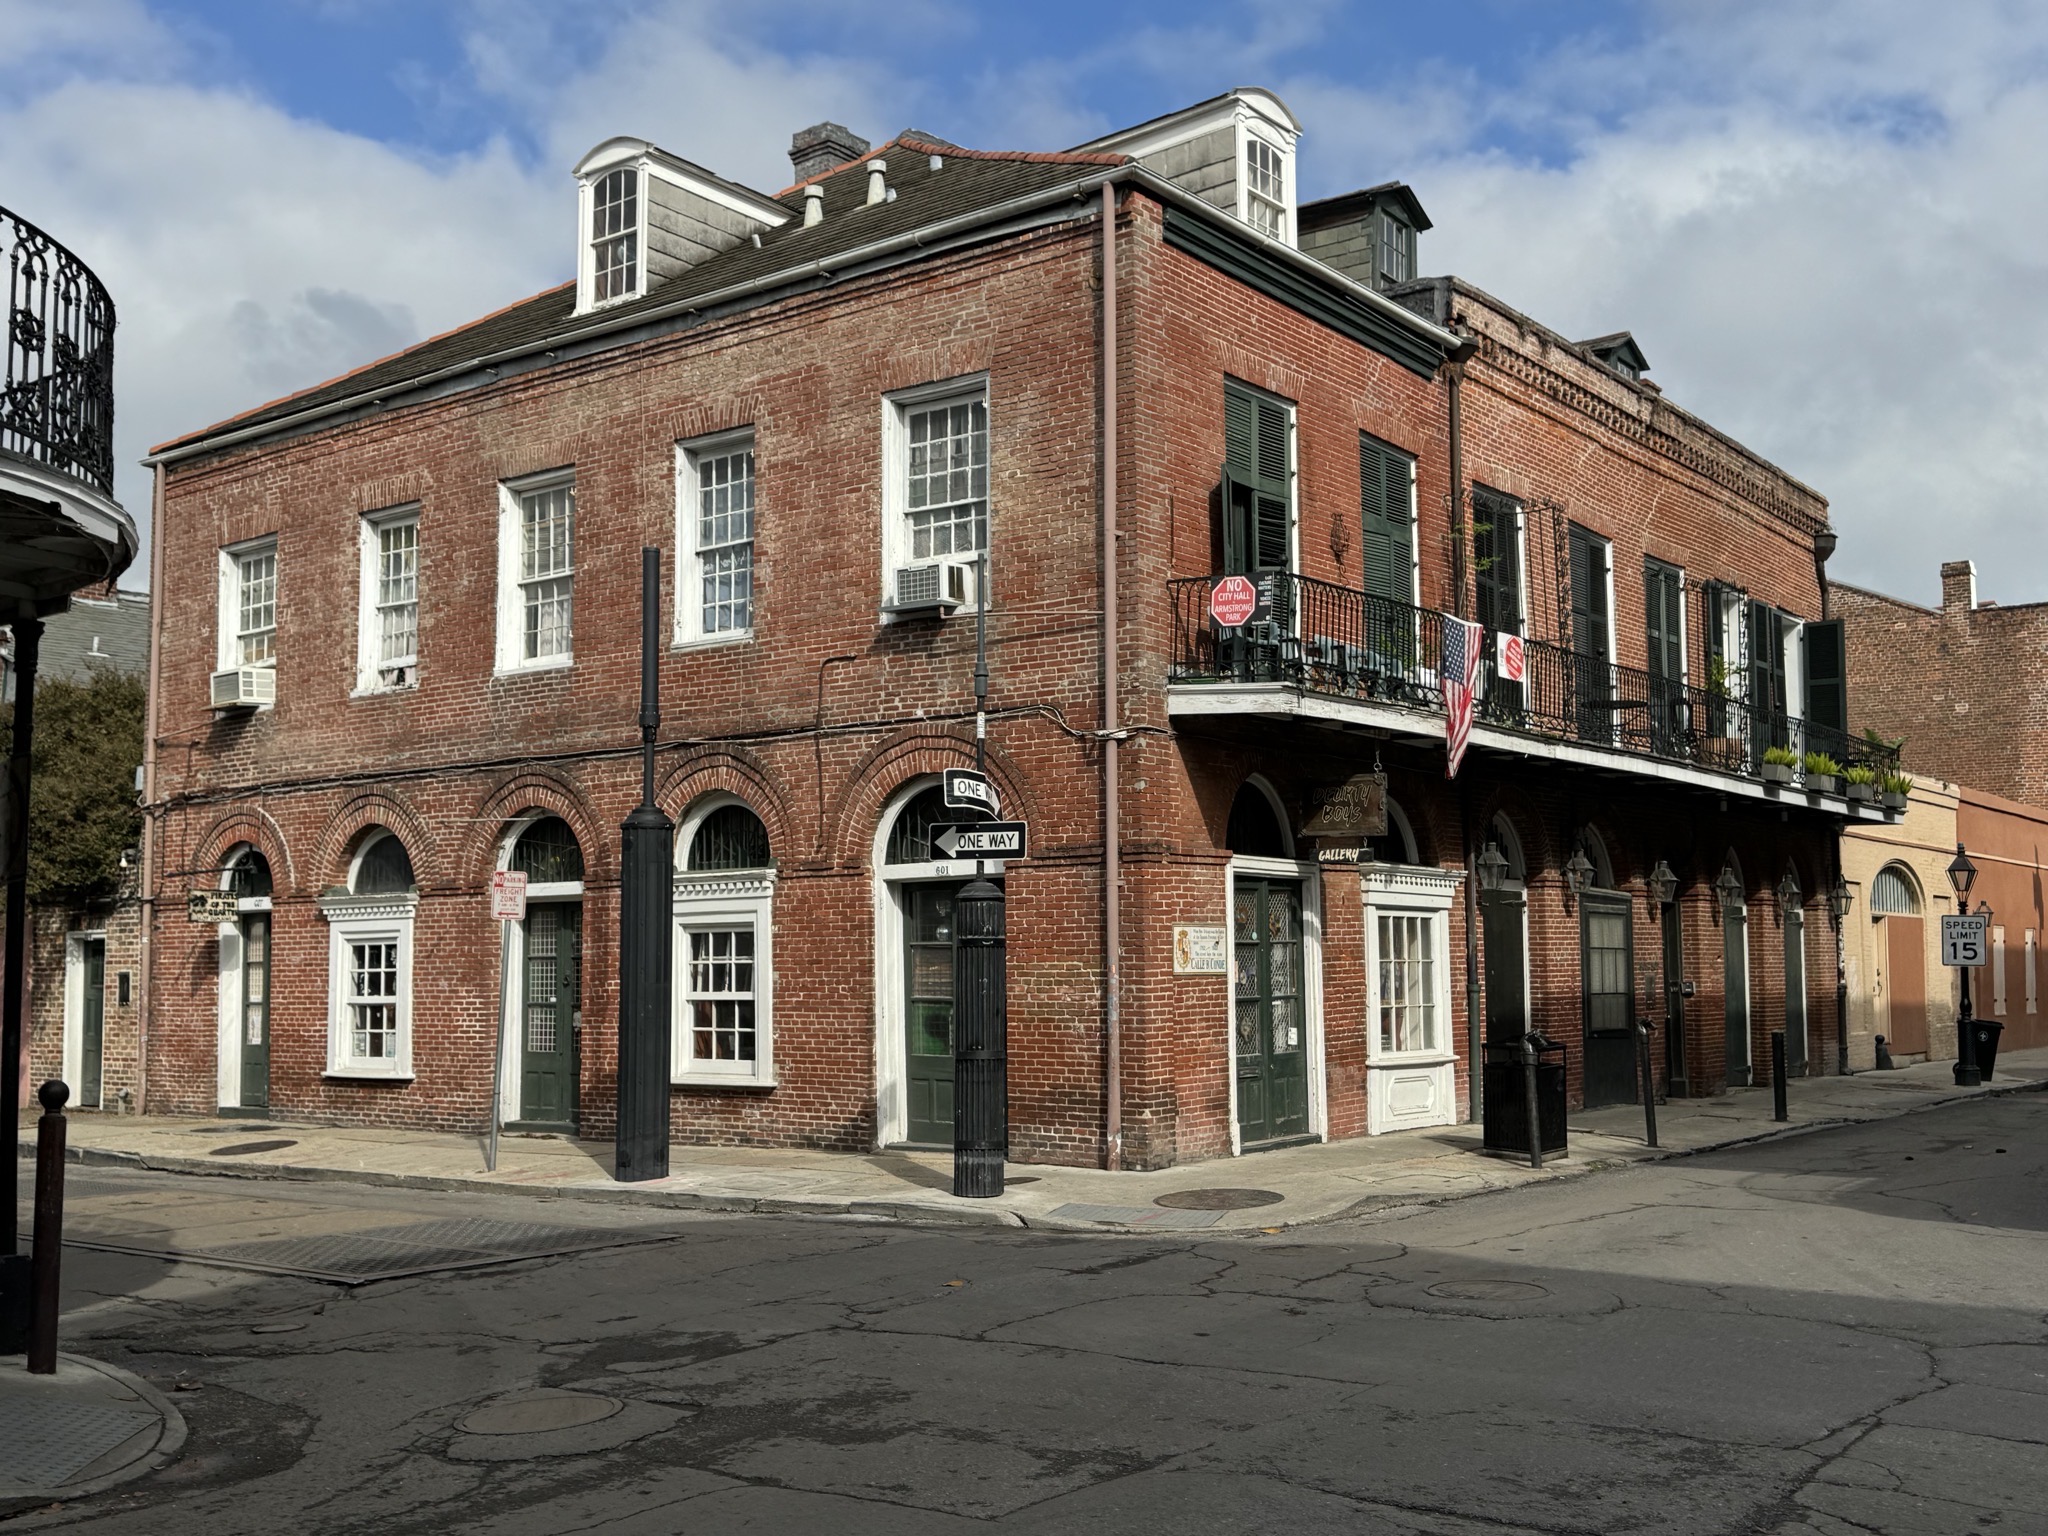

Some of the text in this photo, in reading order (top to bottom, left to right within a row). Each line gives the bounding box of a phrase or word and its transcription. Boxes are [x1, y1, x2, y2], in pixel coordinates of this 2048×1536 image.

[1226, 580, 1242, 592] NO
[1218, 591, 1250, 601] CITY HALL
[1214, 603, 1252, 613] ARMSTRONG
[1225, 613, 1241, 621] PARK
[958, 780, 982, 797] ONE
[1321, 804, 1363, 828] BOYS
[958, 833, 1015, 849] ONE WAY
[1318, 847, 1360, 863] GALLERY
[935, 865, 950, 876] 601
[496, 888, 522, 896] FREIGHT
[500, 895, 518, 903] ZONE
[1945, 921, 1982, 930] SPEED
[1949, 931, 1978, 940] LIMIT
[1950, 941, 1978, 961] 15
